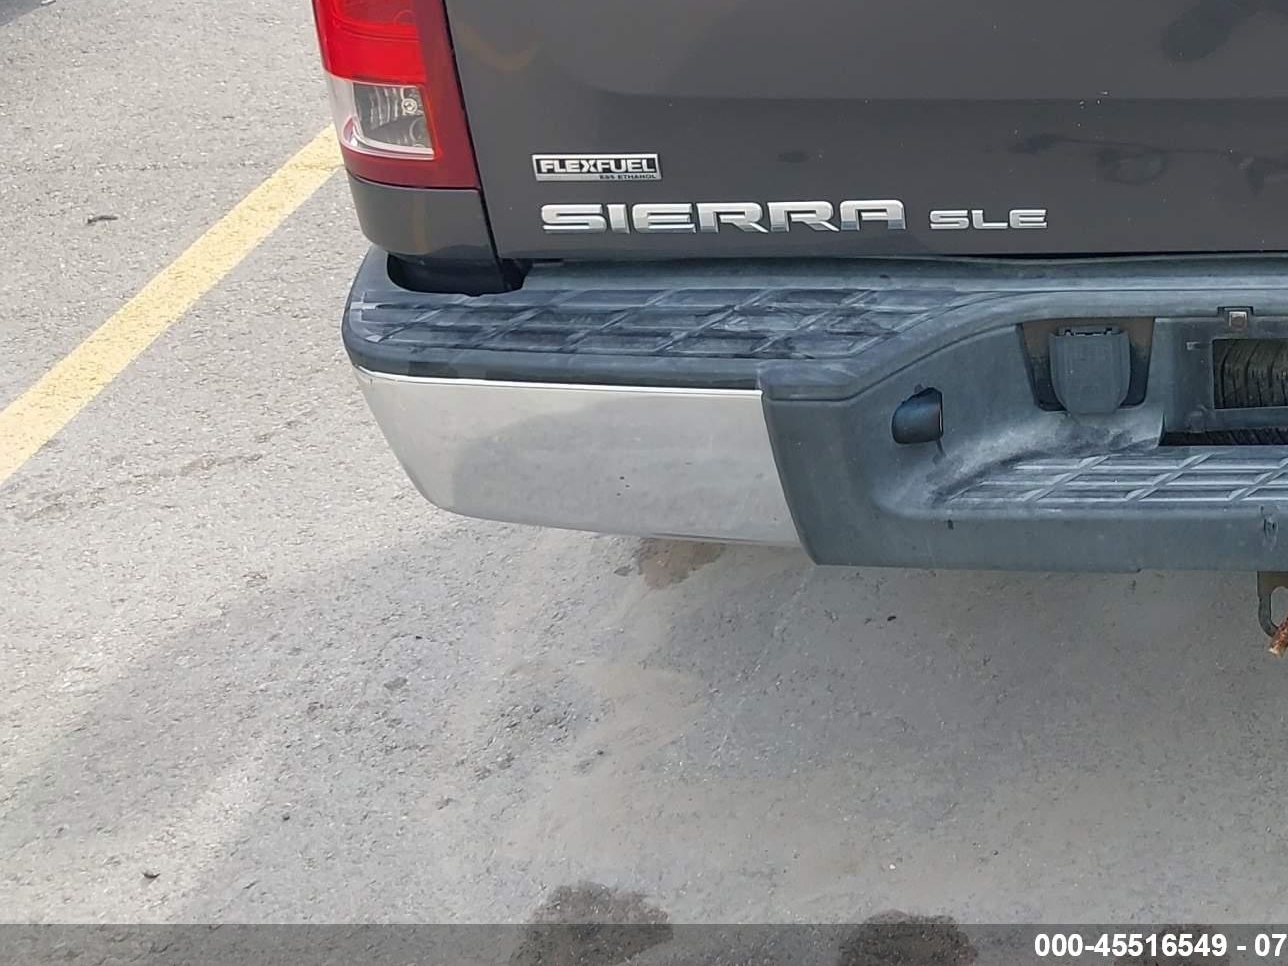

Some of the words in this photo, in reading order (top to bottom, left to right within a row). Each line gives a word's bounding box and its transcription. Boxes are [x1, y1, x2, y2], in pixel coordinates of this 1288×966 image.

[539, 159, 656, 173] FLEXFUEL
[541, 199, 906, 234] SIERRA
[930, 209, 1048, 230] SLE
